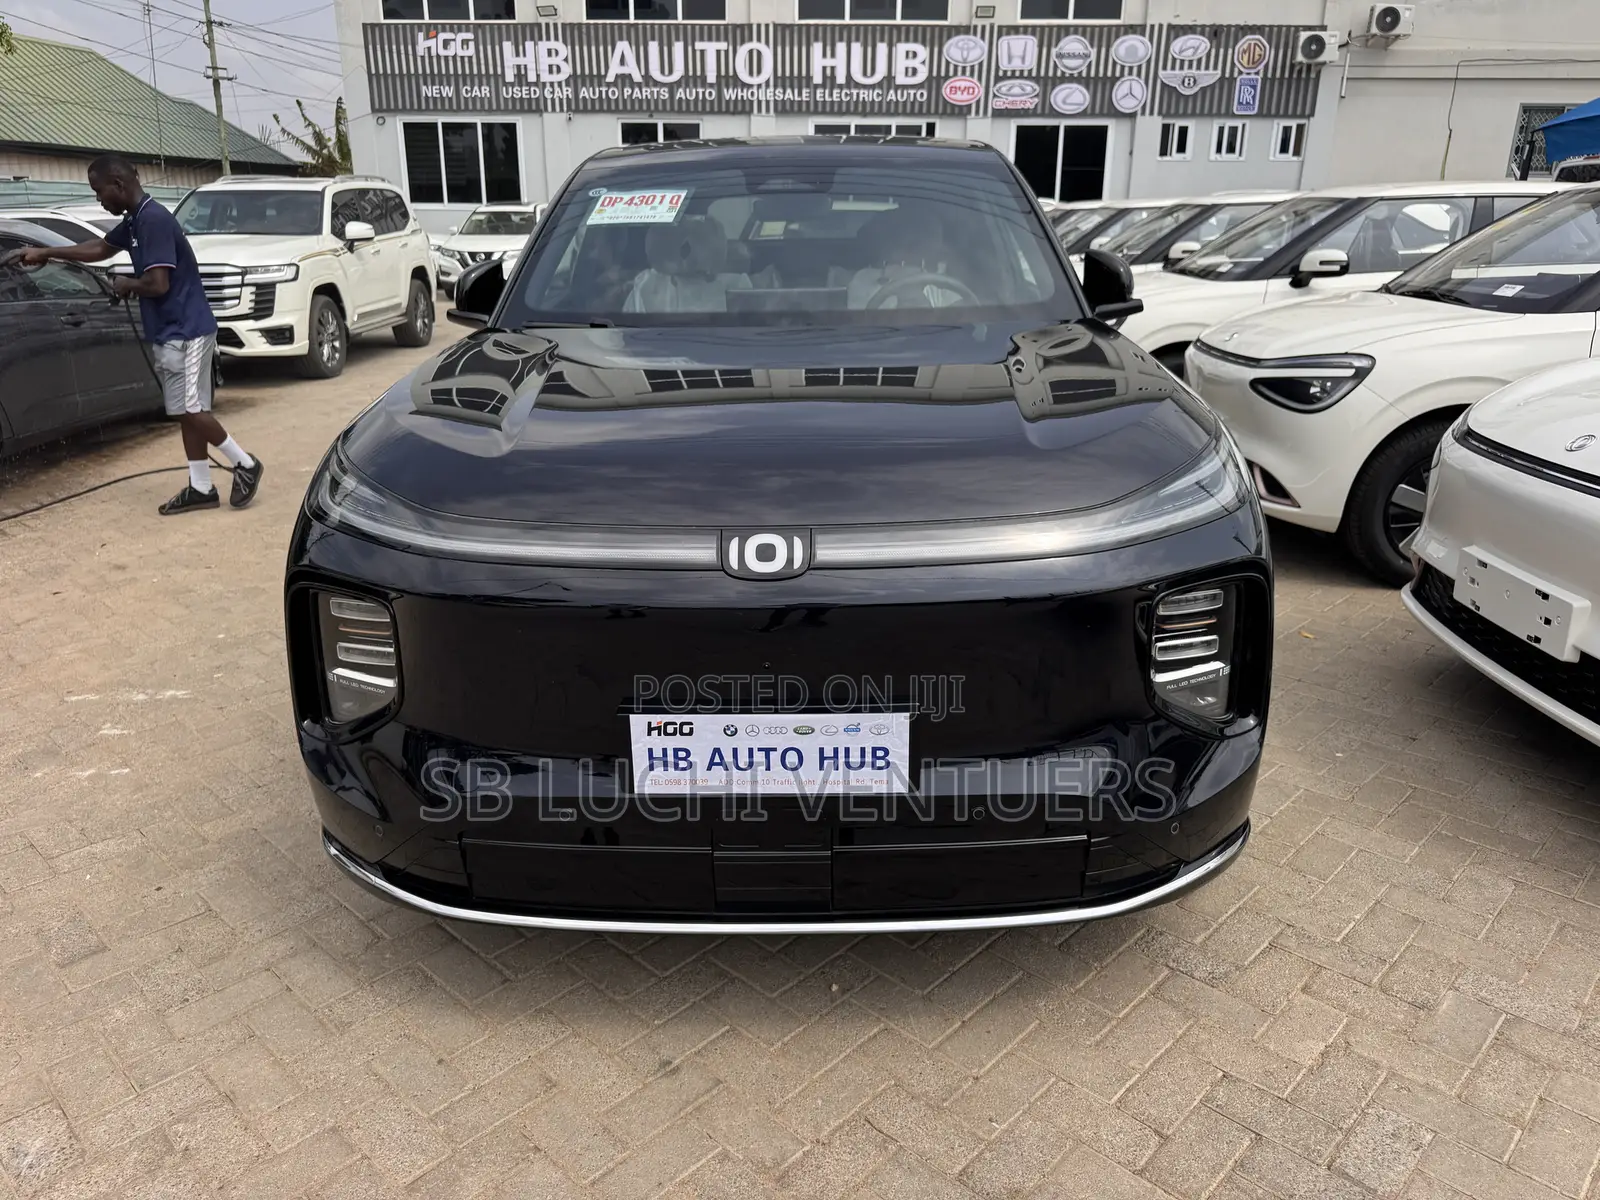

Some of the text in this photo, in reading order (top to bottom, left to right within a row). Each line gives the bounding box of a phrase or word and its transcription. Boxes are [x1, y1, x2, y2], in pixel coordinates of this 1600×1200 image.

[416, 30, 475, 57] HGG
[502, 40, 930, 86] HB AUTO HUB
[1055, 51, 1092, 59] NISSAN
[1241, 42, 1265, 68] MG
[422, 85, 928, 102] NEW CAR USED CAR AUTO PARTS AUTO WHOLESALE ELECTRIC AUTO
[949, 86, 976, 96] BYD
[993, 99, 1039, 109] CHERY
[1189, 673, 1217, 684] TECHNOLOGY
[646, 720, 694, 737] HGG
[647, 746, 891, 772] HB AUTO HUB
[664, 778, 682, 786] 0598
